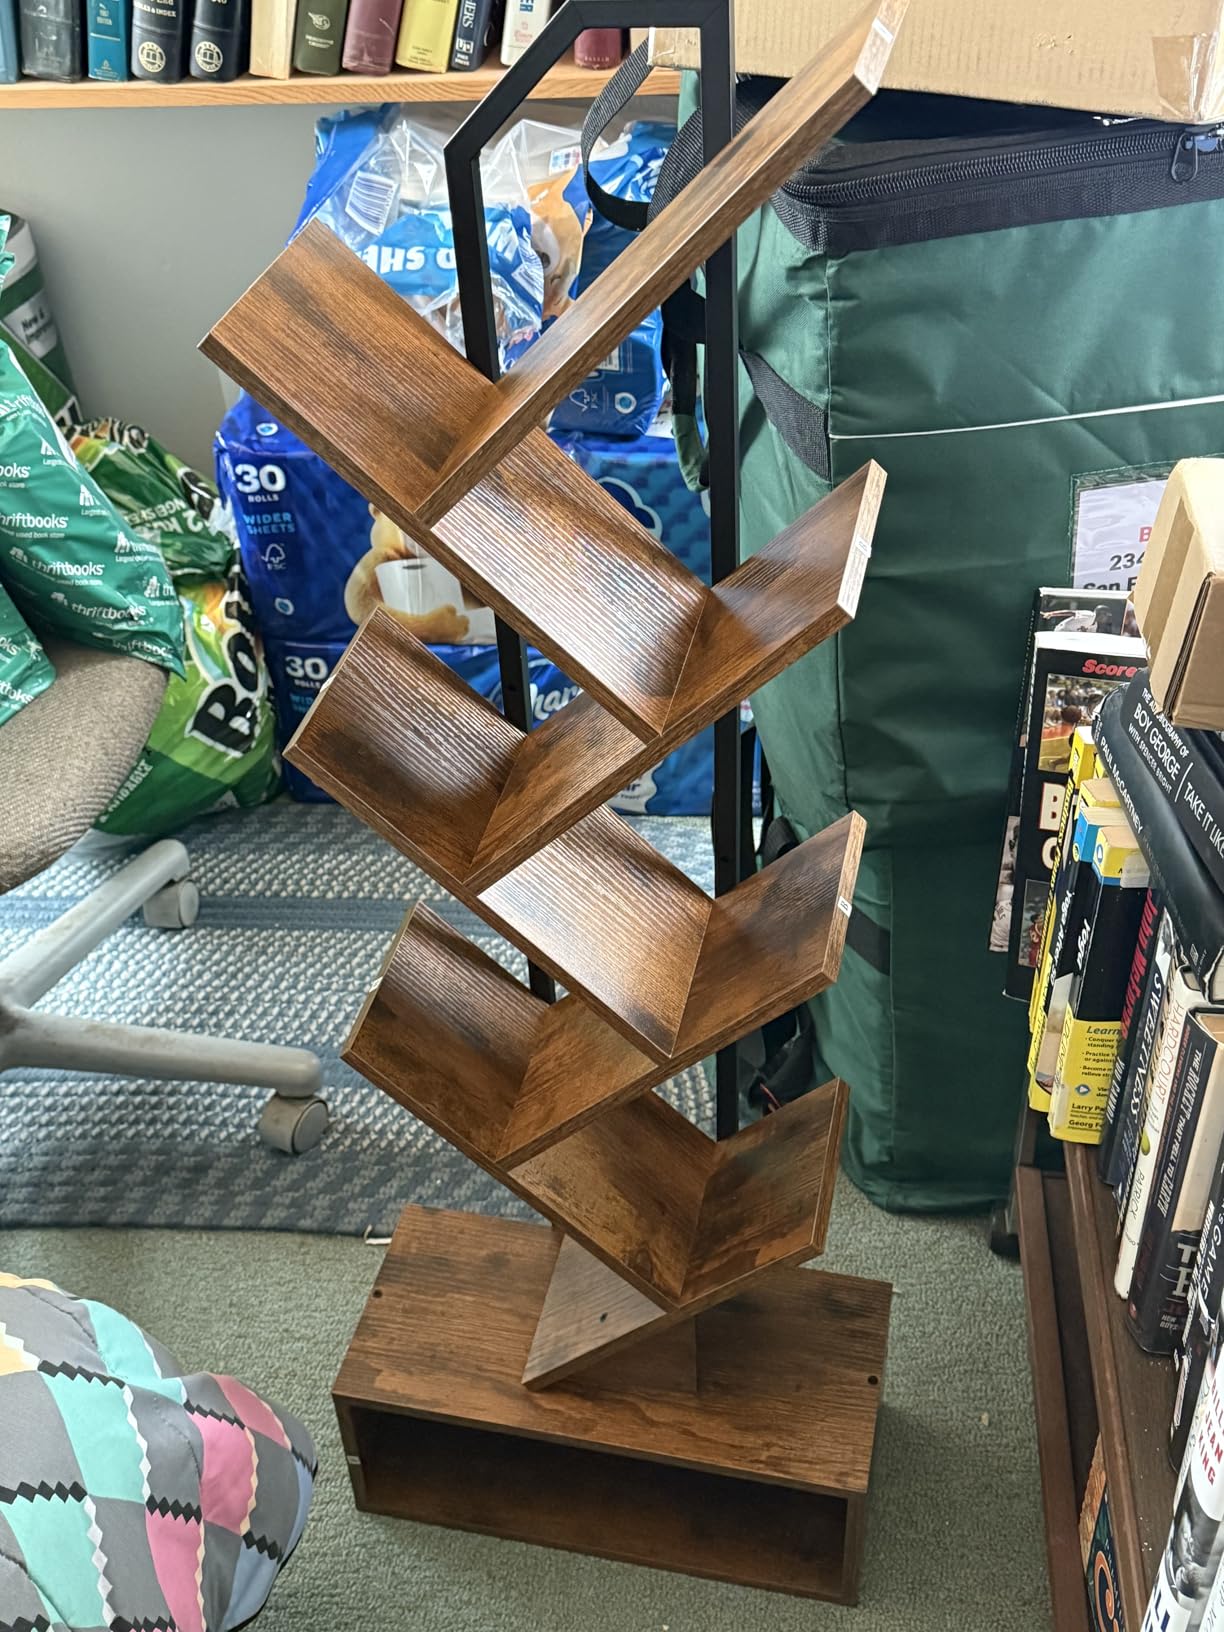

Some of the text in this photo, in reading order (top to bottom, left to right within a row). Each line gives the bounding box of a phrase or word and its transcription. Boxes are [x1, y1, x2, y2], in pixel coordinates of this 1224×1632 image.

[234, 464, 286, 493] 30
[248, 494, 279, 503] ROLLS
[242, 512, 292, 525] WIDER
[246, 523, 296, 535] SHEETS
[32, 560, 104, 577] thriftbooks
[284, 656, 329, 681] 30
[1133, 702, 1181, 781] BOY GEORGE
[1142, 687, 1152, 704] THE
[1179, 745, 1190, 758] OF
[1128, 722, 1173, 794] WITH SPENCER BRIGHT
[1100, 735, 1143, 834] PAUL McCARTNEY
[1183, 781, 1224, 859] TAKE IT LIKE
[1061, 890, 1075, 926] Yoga
[1138, 887, 1158, 949] John
[1055, 926, 1068, 962] After
[1076, 918, 1091, 970] Yoga
[1121, 944, 1148, 1040] McEnroe
[1087, 1026, 1120, 1035] Learn
[1131, 973, 1163, 1122] SWEETNESS
[1157, 1001, 1185, 1107] HARDCOURT
[1191, 1049, 1203, 1070] THE
[1072, 1103, 1093, 1112] Larry
[1106, 1056, 1125, 1124] YOU CANNOT
[1177, 1068, 1201, 1120] ROCKET
[1069, 1119, 1093, 1129] Georg
[1174, 1116, 1187, 1141] THAT
[1166, 1163, 1175, 1176] TO
[1169, 1140, 1181, 1164] FELL
[1133, 1172, 1146, 1220] PATRICK
[1154, 1173, 1176, 1218] EARTH
[1200, 1225, 1222, 1299] GAME
[1199, 1430, 1216, 1486] KING
[1206, 1410, 1223, 1464] JEAN
